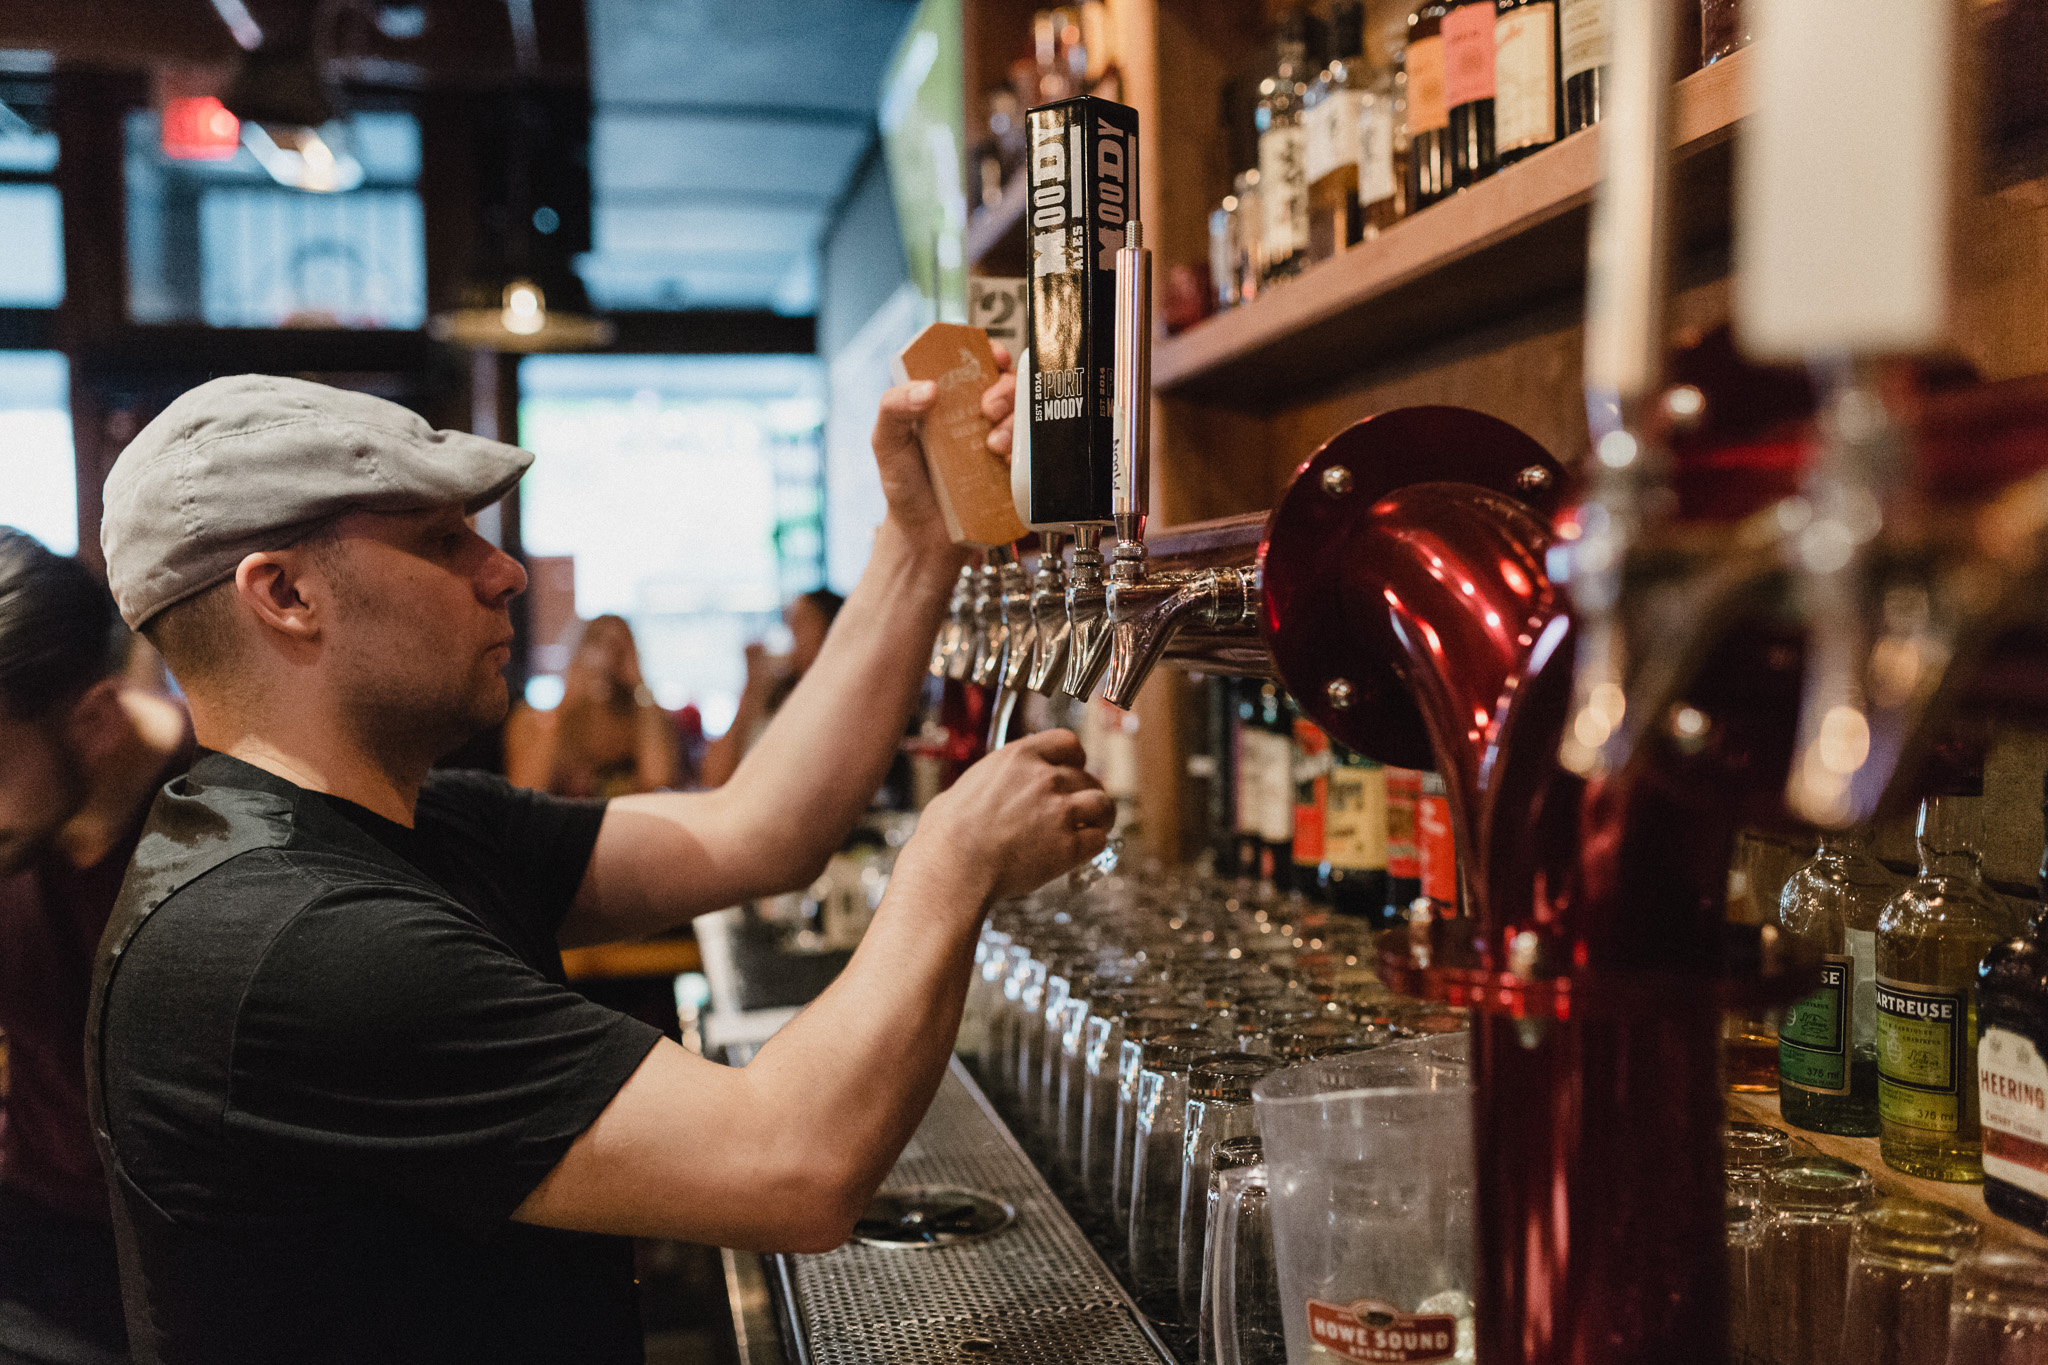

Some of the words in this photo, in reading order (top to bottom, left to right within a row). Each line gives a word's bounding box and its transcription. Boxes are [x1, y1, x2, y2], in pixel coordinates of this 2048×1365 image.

[1032, 126, 1066, 278] MOODY
[1097, 117, 1125, 272] MOODY
[1072, 225, 1084, 271] ALES
[1034, 371, 1042, 401] 2014
[1043, 366, 1085, 399] PORT
[1043, 396, 1084, 421] MOODY
[1876, 991, 1953, 1019] ARTREUSE
[1313, 1316, 1369, 1347] HOWE
[1374, 1329, 1450, 1351] SOUND
